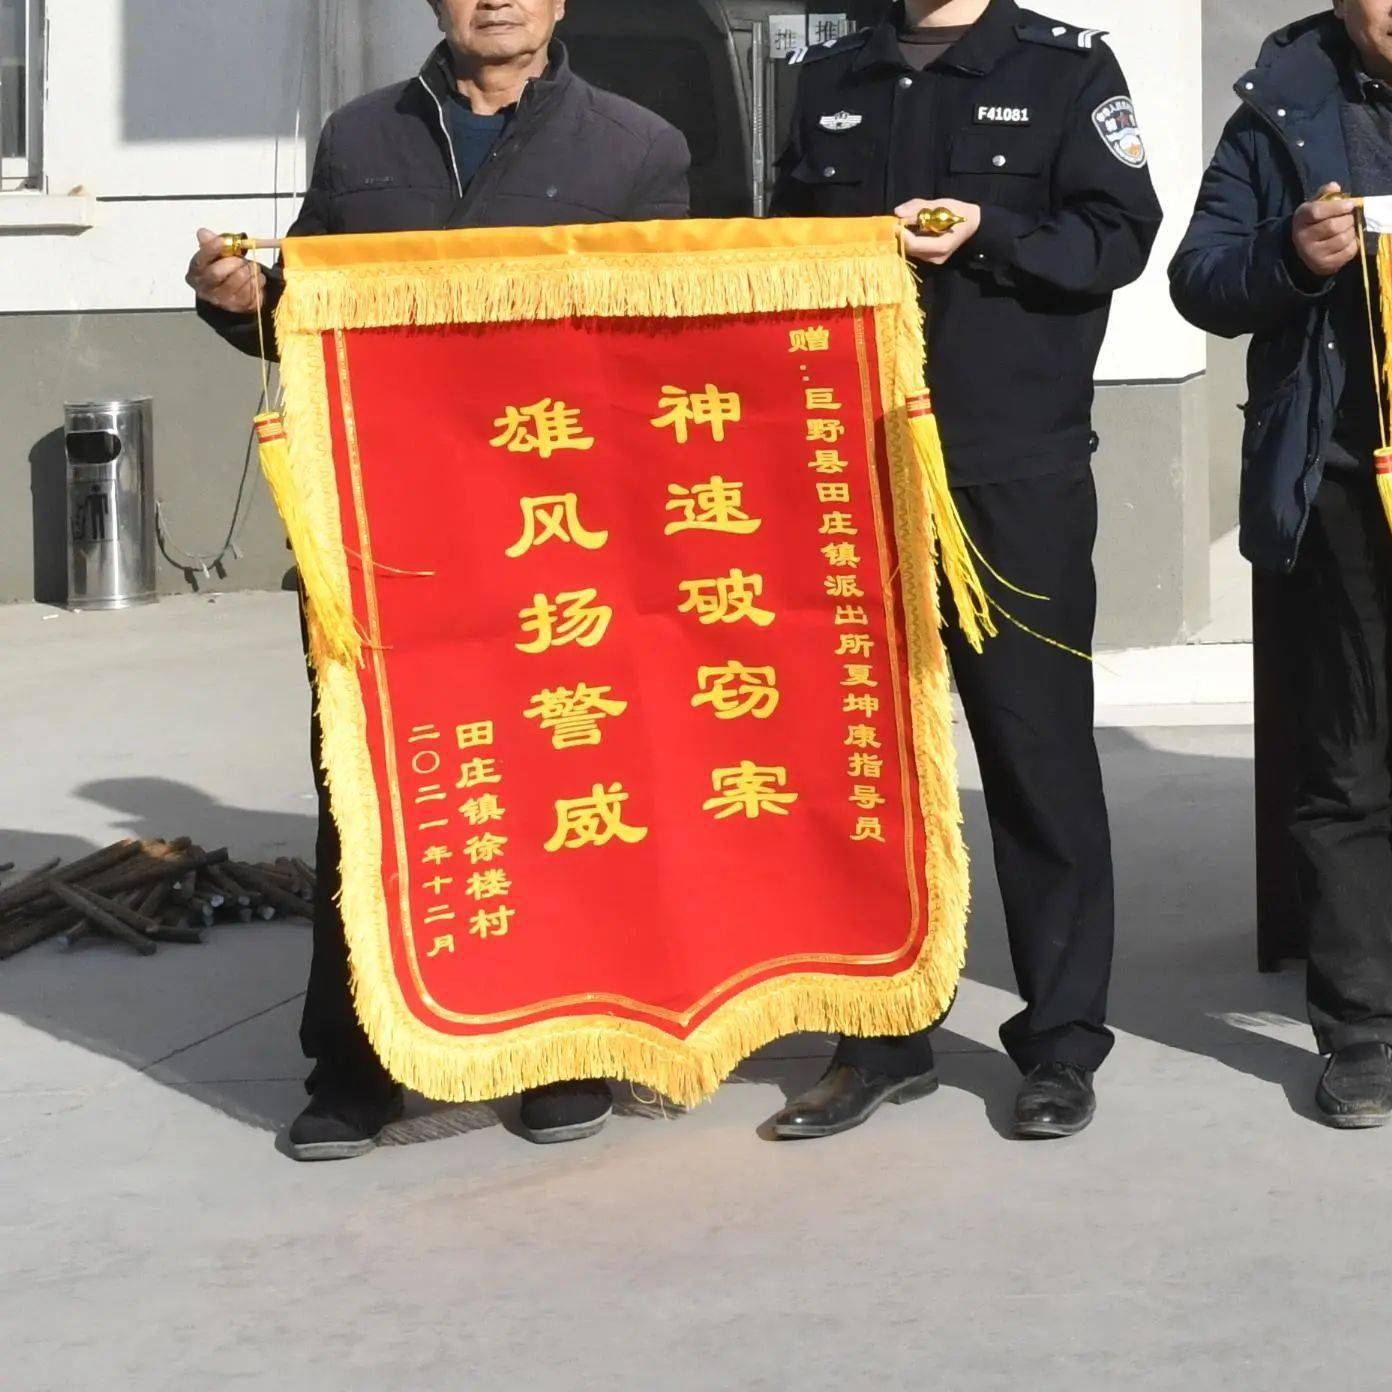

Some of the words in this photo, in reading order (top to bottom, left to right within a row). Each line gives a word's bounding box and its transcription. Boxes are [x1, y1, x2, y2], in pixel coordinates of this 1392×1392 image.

[977, 105, 1030, 123] F41081
[489, 395, 648, 854] 雄风扬警威
[650, 383, 799, 822] 神速破窃案
[454, 719, 516, 939] 田庄镇徐楼村
